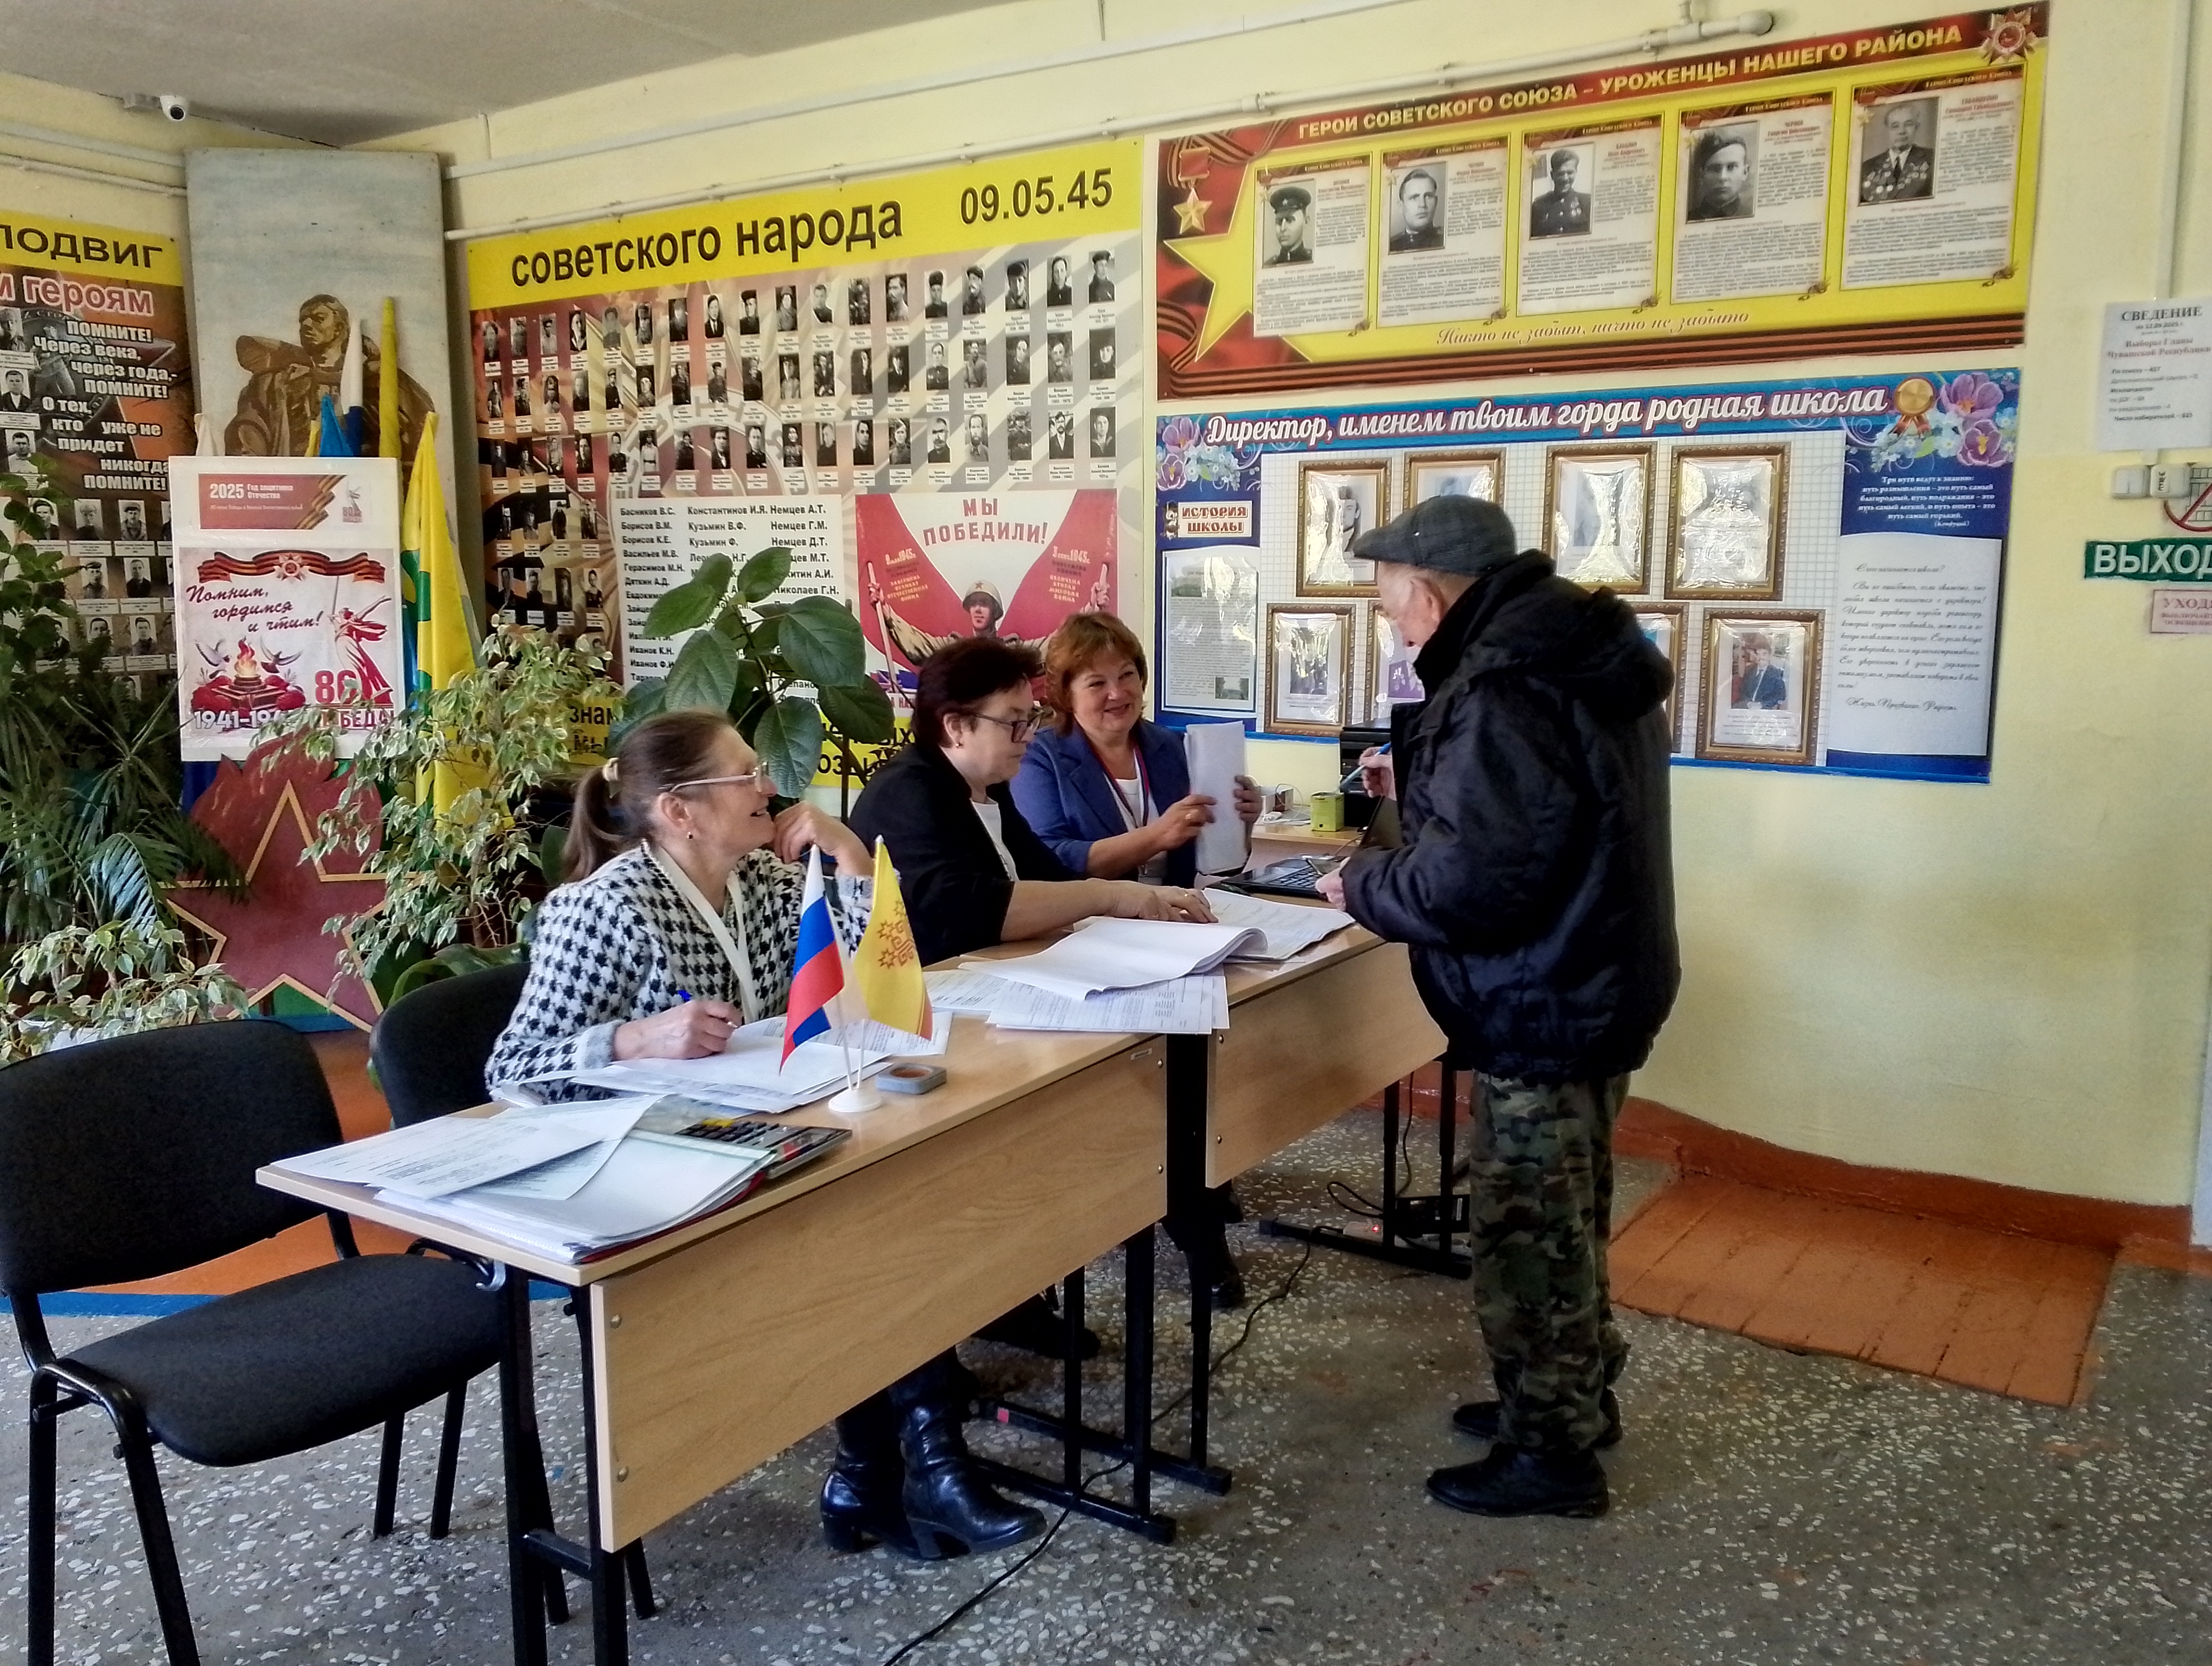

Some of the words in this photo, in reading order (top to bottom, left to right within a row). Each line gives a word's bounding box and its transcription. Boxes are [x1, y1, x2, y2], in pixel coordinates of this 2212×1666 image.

[1299, 116, 1359, 139] ГЕРОИ
[1364, 95, 1493, 129] СОВЕТСКОГО
[1500, 82, 1578, 109] СОЮЗА
[1600, 61, 1737, 95] УРОЖЕНЦЫ
[1743, 41, 1849, 74] НАШЕГО
[1855, 25, 1963, 58] РАЙОНА
[961, 167, 1113, 225] 09.05.45
[511, 225, 722, 286] советского
[736, 199, 904, 262] народа
[23, 275, 154, 317] героям
[2121, 306, 2203, 321] СВЕДЕНИЕ
[66, 320, 153, 342] ПОМНИТЕ!
[1437, 326, 1497, 345] Никто
[1501, 329, 1520, 341] не
[1518, 320, 1587, 345] забыт,
[1591, 319, 1646, 334] ничто
[1651, 318, 1671, 330] не
[1669, 307, 1750, 334] забыто
[34, 335, 92, 356] Через
[95, 343, 142, 361] века,
[2125, 339, 2162, 348] Выборы
[2108, 350, 2156, 358] Чувашской
[2159, 347, 2211, 355] Республики
[71, 360, 125, 377] через
[84, 379, 169, 399] ПОМНИТЕ!
[42, 396, 55, 411] О
[56, 399, 92, 414] тех,
[1206, 415, 1333, 446] Директор,
[1339, 411, 1446, 437] именем
[1450, 399, 1552, 432] твоим
[1557, 399, 1643, 433] горда
[1645, 392, 1765, 430] родная
[1771, 387, 1888, 416] школа
[52, 418, 85, 432] кто
[101, 421, 137, 434] уже
[140, 422, 162, 436] не
[57, 437, 125, 453] придет
[83, 474, 167, 491] ПОМНИТЕ!
[1882, 476, 1897, 484] Три
[210, 483, 244, 499] 2025
[247, 484, 259, 492] Год
[687, 506, 747, 515] Константинов
[750, 505, 768, 515] И.Я.
[770, 505, 806, 515] Немцев
[808, 504, 826, 514] А.Т.
[962, 498, 999, 517] МЫ
[1182, 506, 1248, 518] ИСТОРИЯ
[621, 521, 654, 532] Борисов
[688, 522, 725, 532] Кузьмин
[771, 521, 806, 531] Немцев
[808, 521, 828, 530] Г.М.
[1187, 521, 1244, 534] ШКОЛЫ
[622, 535, 655, 545] Борисов
[923, 521, 1048, 546] ПОБЕДИЛИ!
[689, 537, 726, 548] Кузьмин
[728, 537, 738, 546] Ф.
[771, 537, 807, 547] Немцев
[809, 537, 828, 548] Д.Т.
[623, 549, 660, 558] Васильев
[792, 554, 807, 563] цев
[810, 553, 829, 562] М.Т.
[624, 563, 666, 573] Герасимов
[814, 569, 834, 579] А.И.
[186, 585, 268, 603] Помним,
[626, 591, 664, 600] Евдокимо
[774, 586, 819, 594] Николаев
[821, 586, 840, 594] Г.Н.
[212, 600, 293, 622] гордимся
[627, 604, 653, 613] Зайце
[2163, 598, 2212, 610] УХОД
[248, 623, 259, 632] и
[266, 610, 324, 631] чтим!
[629, 645, 658, 654] Иванов
[631, 659, 658, 668] Иванов
[314, 670, 357, 704] 80
[194, 709, 293, 729] 1941-19
[321, 709, 394, 728] БЕДА
